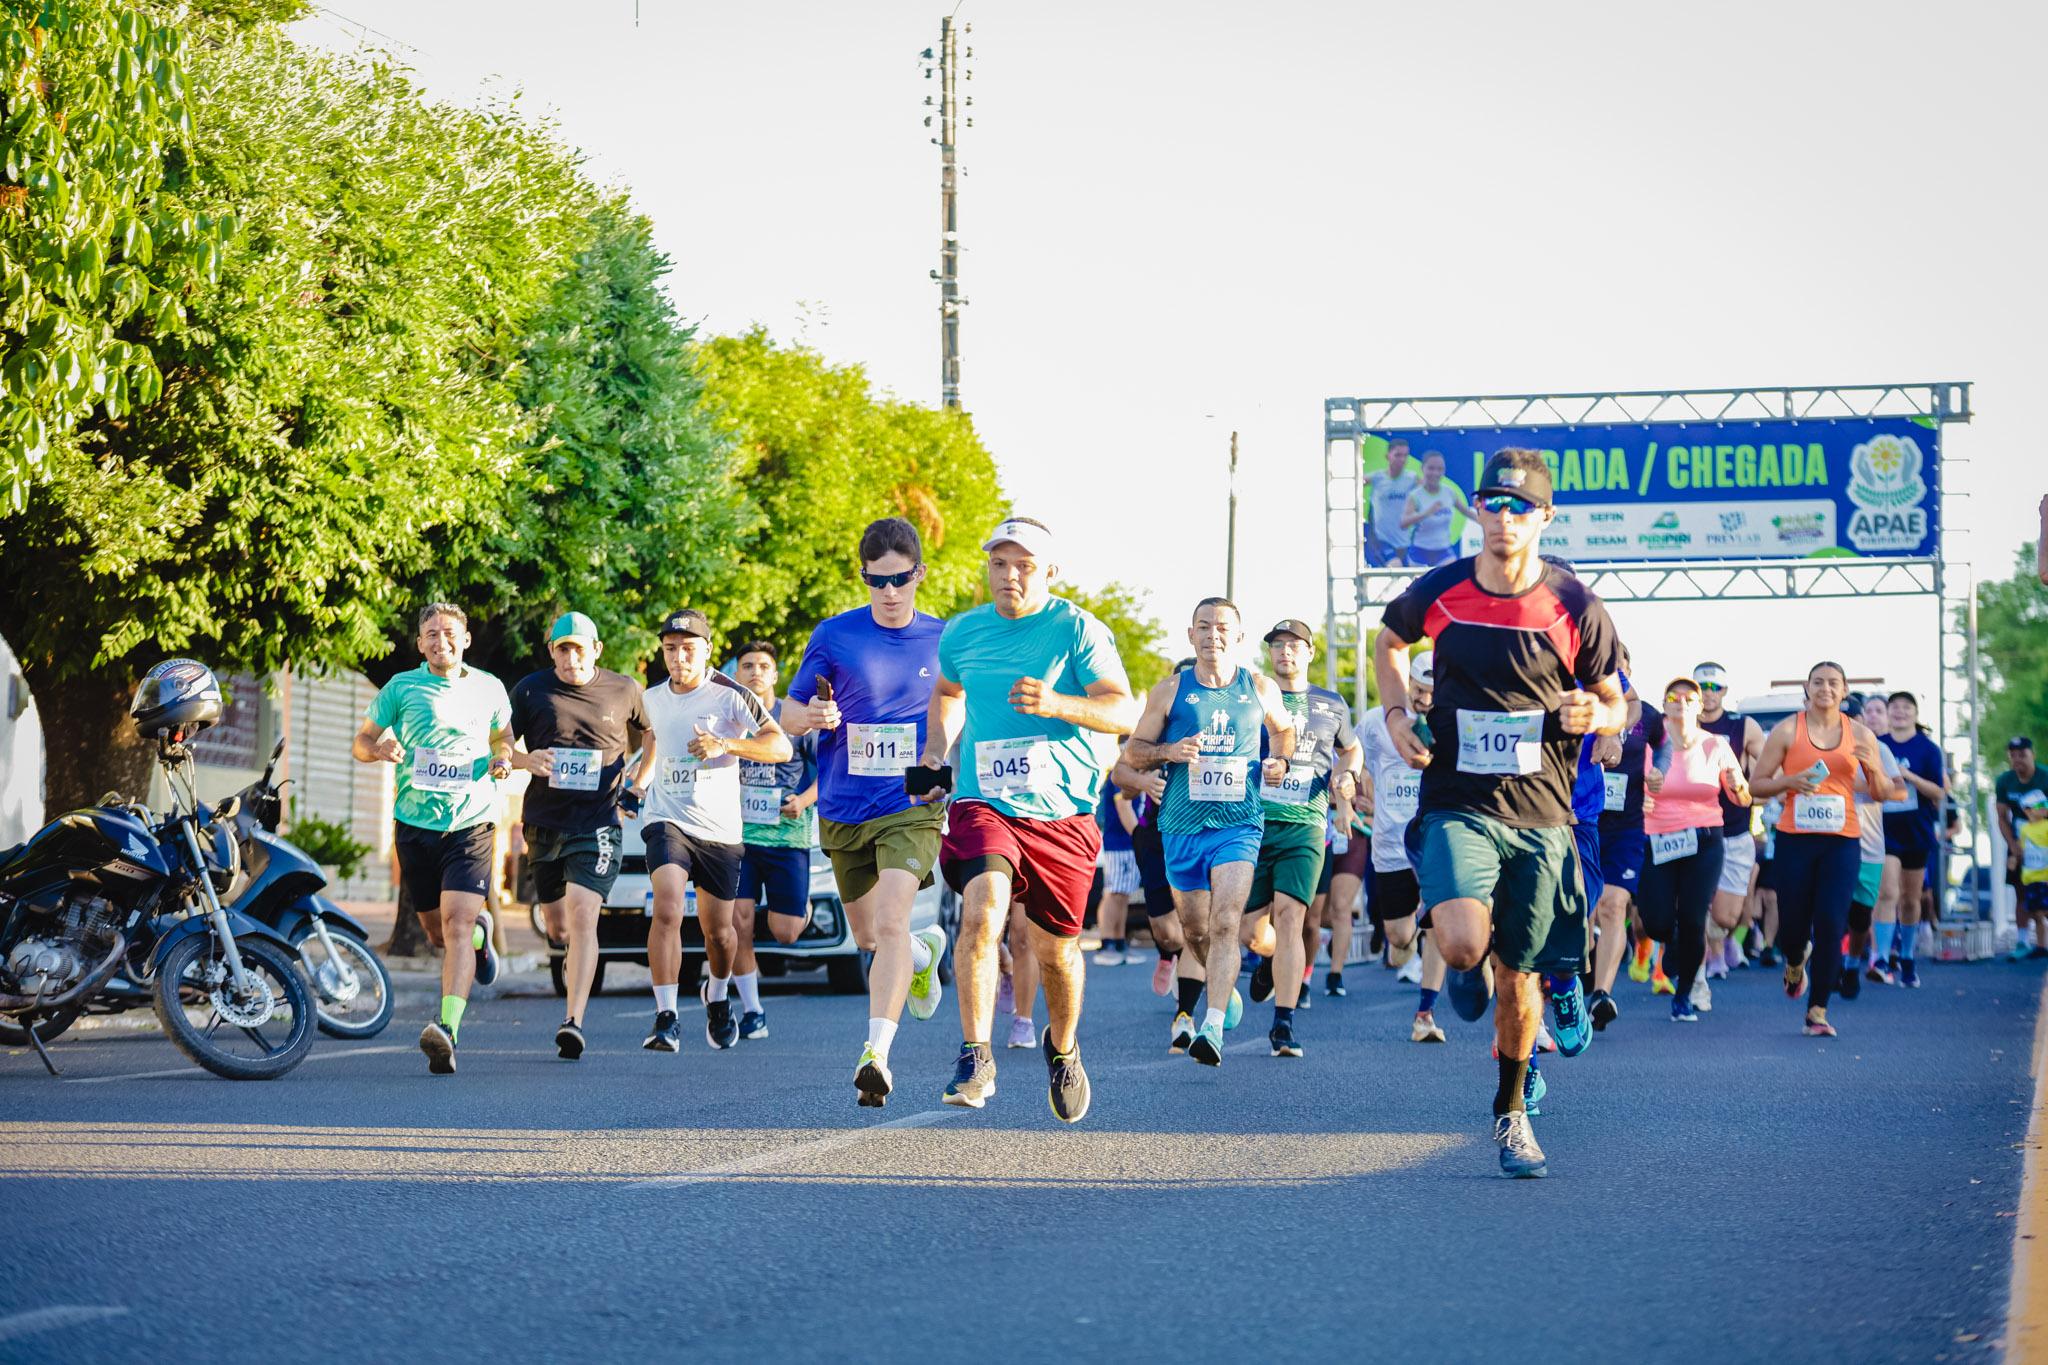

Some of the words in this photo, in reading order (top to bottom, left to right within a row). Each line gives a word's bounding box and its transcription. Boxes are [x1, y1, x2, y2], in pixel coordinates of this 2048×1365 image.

[1473, 447, 1629, 491] LGADA
[1638, 440, 1658, 496] /
[1667, 443, 1829, 489] CHEGADA
[1590, 511, 1624, 523] SEFIN
[1854, 512, 1921, 535] APAE
[1540, 536, 1569, 546] ETAS
[1586, 535, 1627, 546] SESAM
[1638, 533, 1691, 545] PIRIPIRI
[1201, 734, 1235, 746] PIRIPIRI
[1480, 733, 1521, 752] 107
[865, 742, 896, 758] 011
[428, 763, 458, 778] 020
[560, 762, 587, 776] 054
[993, 757, 1031, 778] 045
[672, 769, 698, 784] 021
[1203, 771, 1233, 786] 076
[1283, 778, 1300, 791] 69
[745, 798, 768, 811] 103
[1808, 807, 1832, 819] 066
[1664, 839, 1686, 852] 037
[120, 847, 146, 861] HONDA
